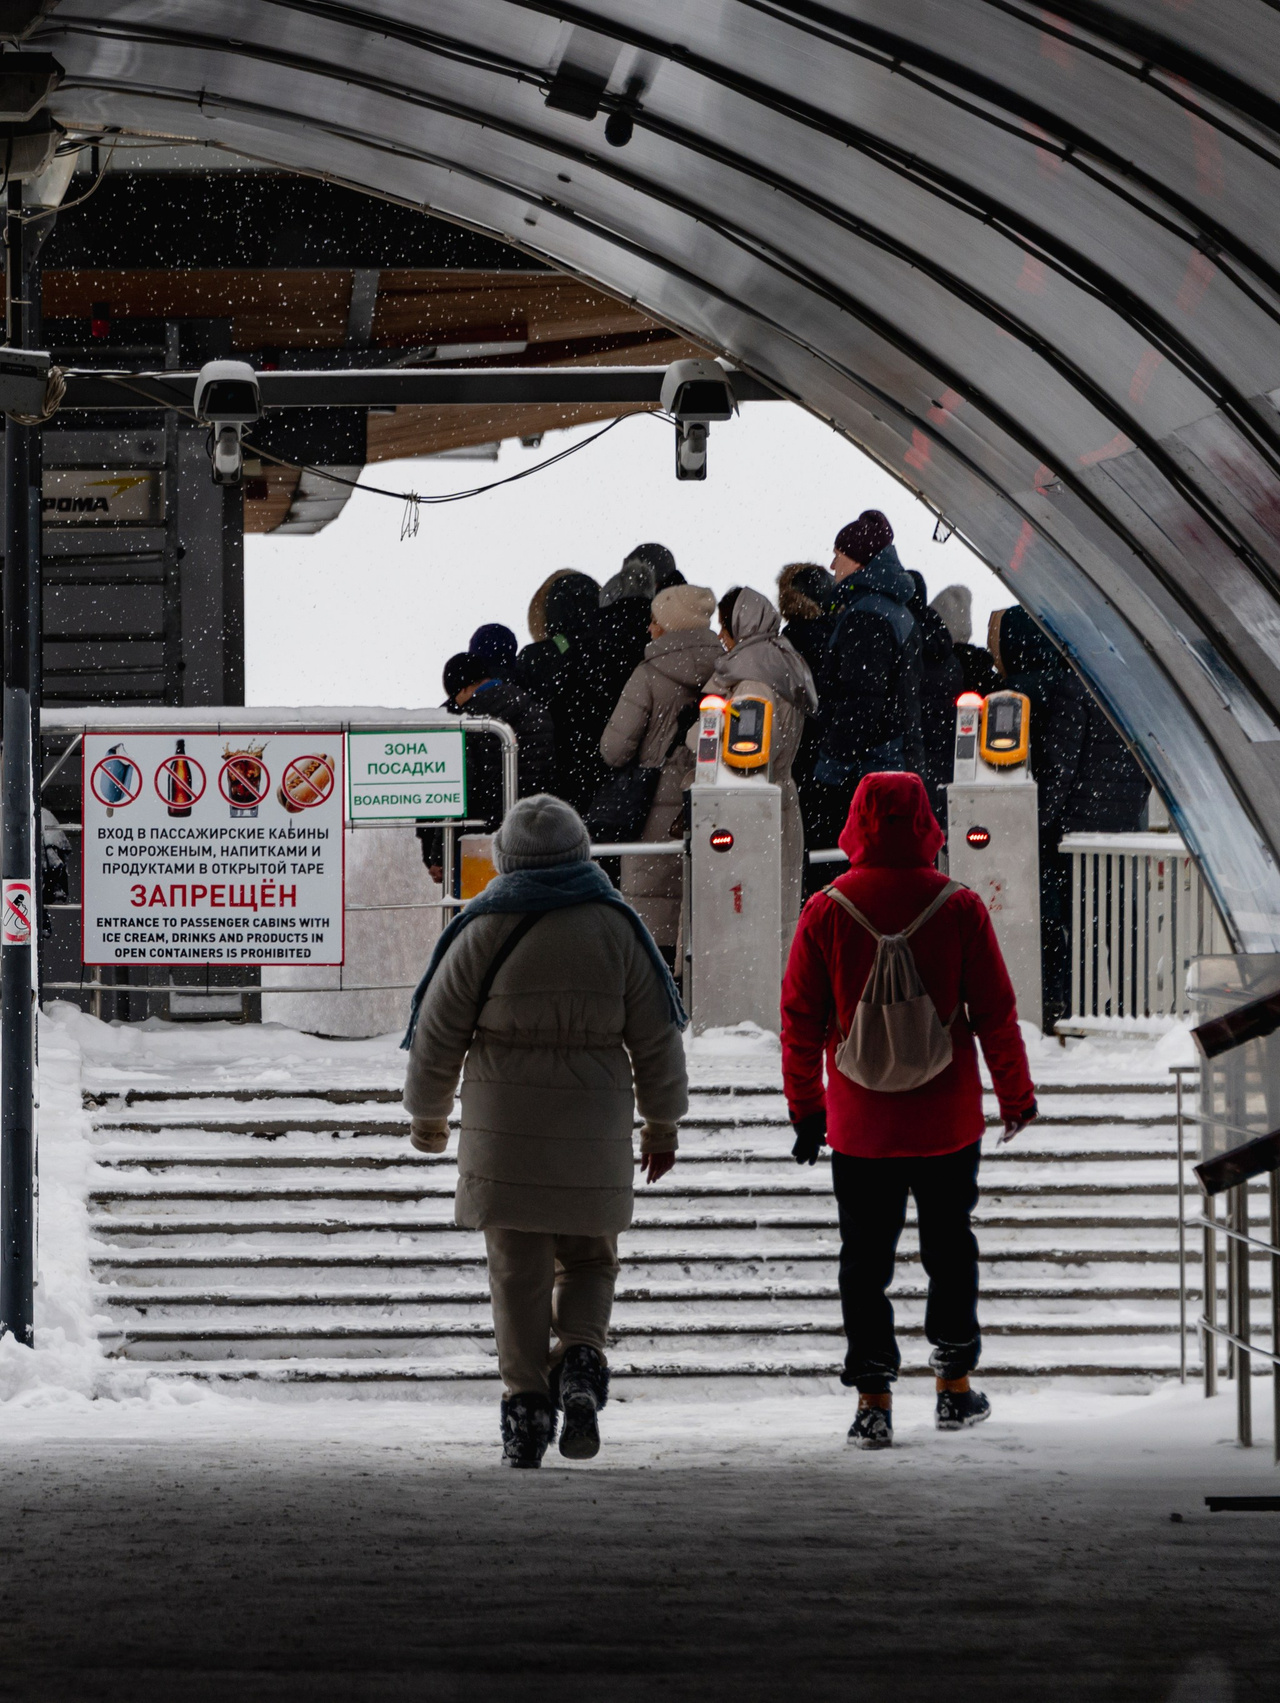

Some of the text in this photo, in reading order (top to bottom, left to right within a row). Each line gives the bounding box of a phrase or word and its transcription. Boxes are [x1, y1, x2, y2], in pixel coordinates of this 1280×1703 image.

[41, 497, 110, 513] POMA
[384, 742, 428, 756] ЗОНА
[367, 761, 446, 777] ПОСАДКИ
[353, 792, 461, 806] BOARDING ZONE
[98, 827, 329, 841] ВХОД В ПАССАЖИРСКИЕ КАБИНЫ
[105, 845, 321, 859] С МОРОЖЕНЫМ, НАПИТКАМИ И
[102, 860, 325, 876] ПРОДУКТАМИ В ОТКРЫТОЙ ТАРЕ
[130, 878, 297, 912] ЗАПРЕЩЁН
[96, 917, 330, 928] ENTRANCE TO PASSENGER CABINS WITH
[102, 932, 324, 944] ICE CREAM, DRINKS AND PRODUCTS IN
[114, 947, 312, 958] OPEN CONTAINERS IS PROHIBITED
